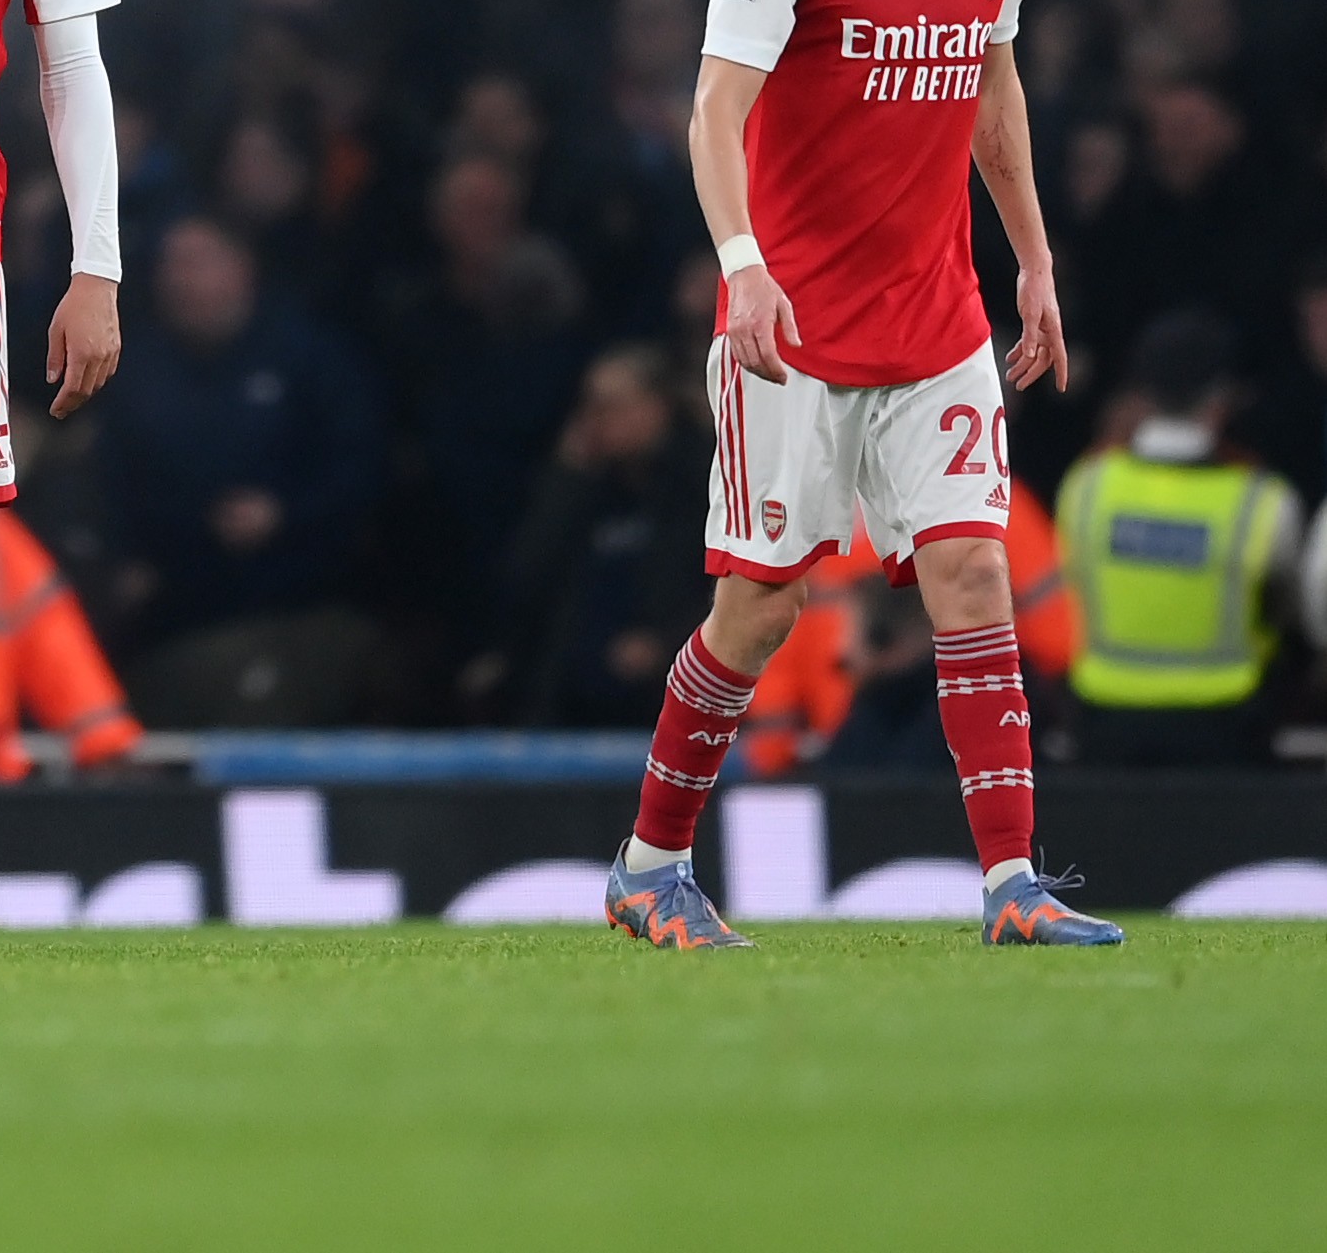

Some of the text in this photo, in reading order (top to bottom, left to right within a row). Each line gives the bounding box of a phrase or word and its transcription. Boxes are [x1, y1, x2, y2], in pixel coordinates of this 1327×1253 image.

[863, 63, 982, 101] FLY BETTER
[939, 403, 1009, 479] 20
